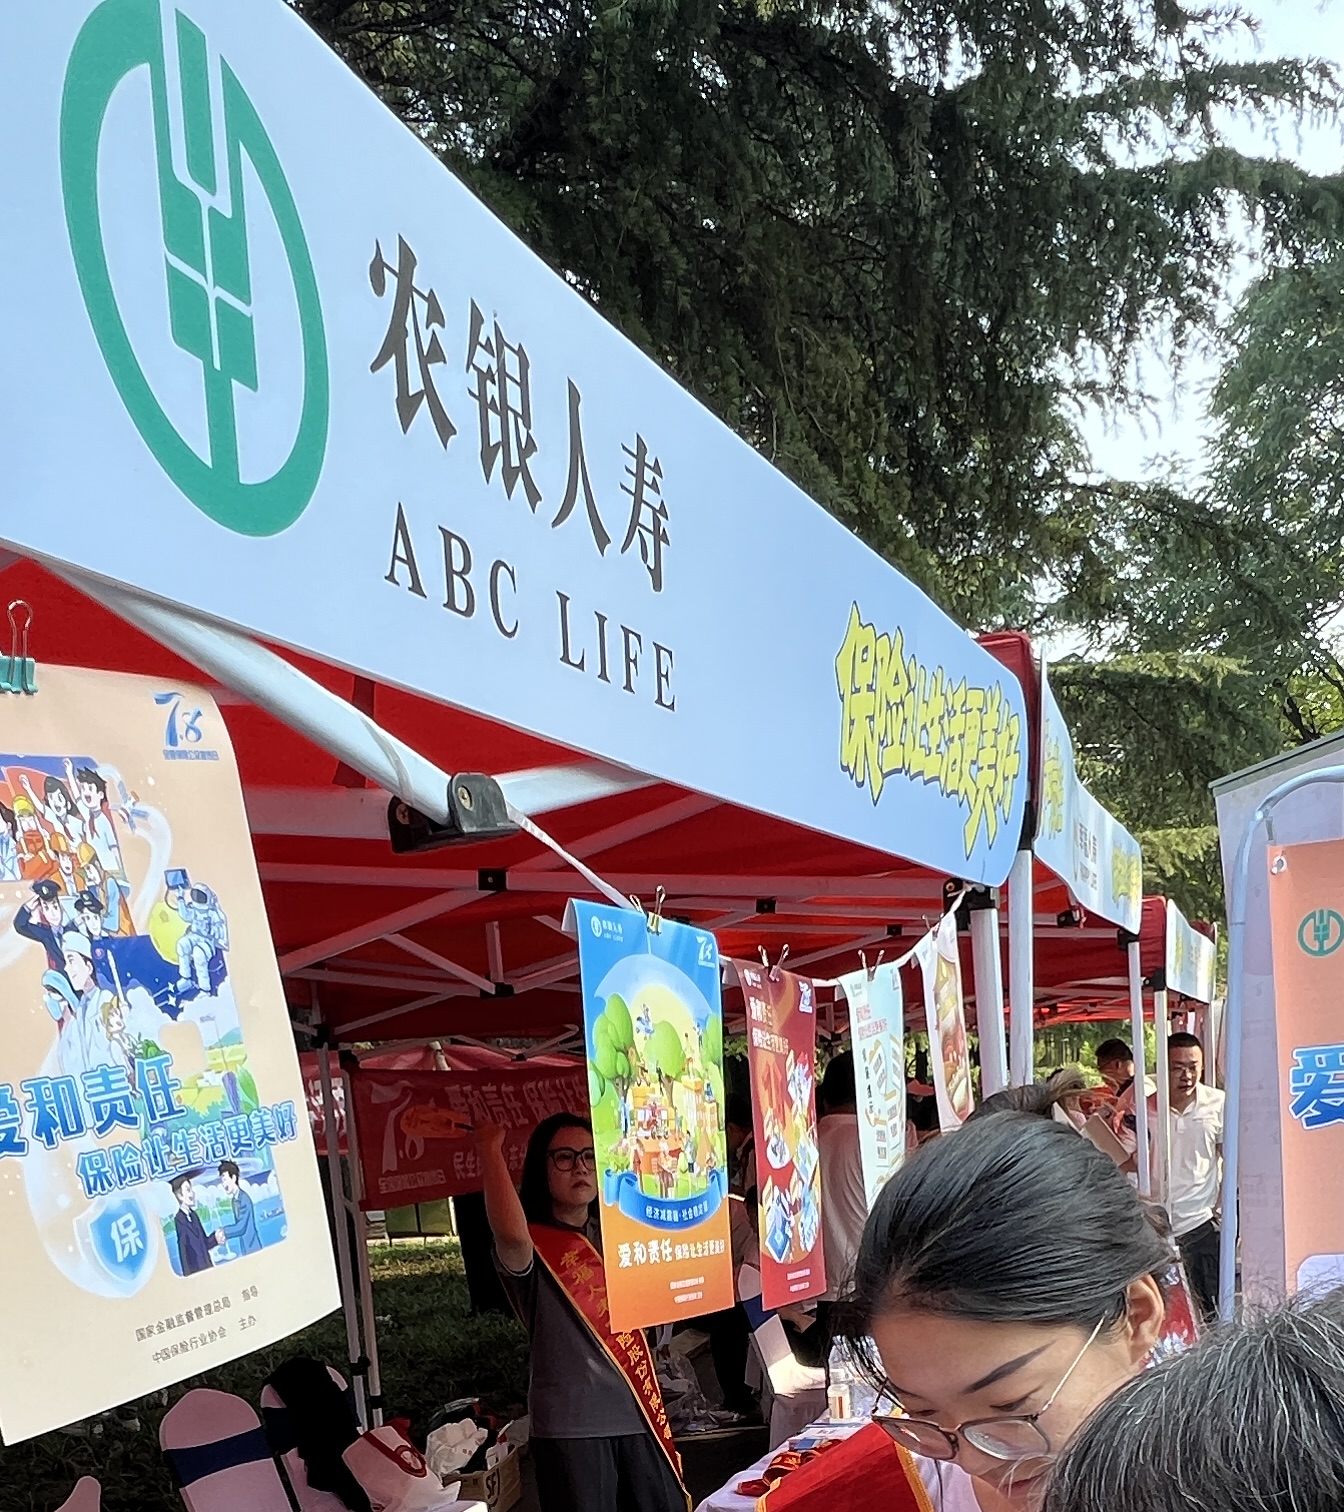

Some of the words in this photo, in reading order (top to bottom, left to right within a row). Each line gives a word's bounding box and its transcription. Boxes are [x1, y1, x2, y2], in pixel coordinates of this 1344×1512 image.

[369, 233, 671, 594] 农银人寿
[385, 501, 520, 641] ABC
[555, 590, 677, 713] LIFE
[835, 601, 1022, 860] 保险让生活更美好
[76, 1099, 301, 1200] 保险让生活更美好
[109, 1211, 146, 1266] 保
[618, 1238, 672, 1268] 爱和责任
[135, 1296, 232, 1342] 国家金融监督管理总局
[241, 1285, 259, 1302] 指导
[152, 1326, 227, 1364] 中国保险行业协会
[238, 1315, 257, 1331] 主办
